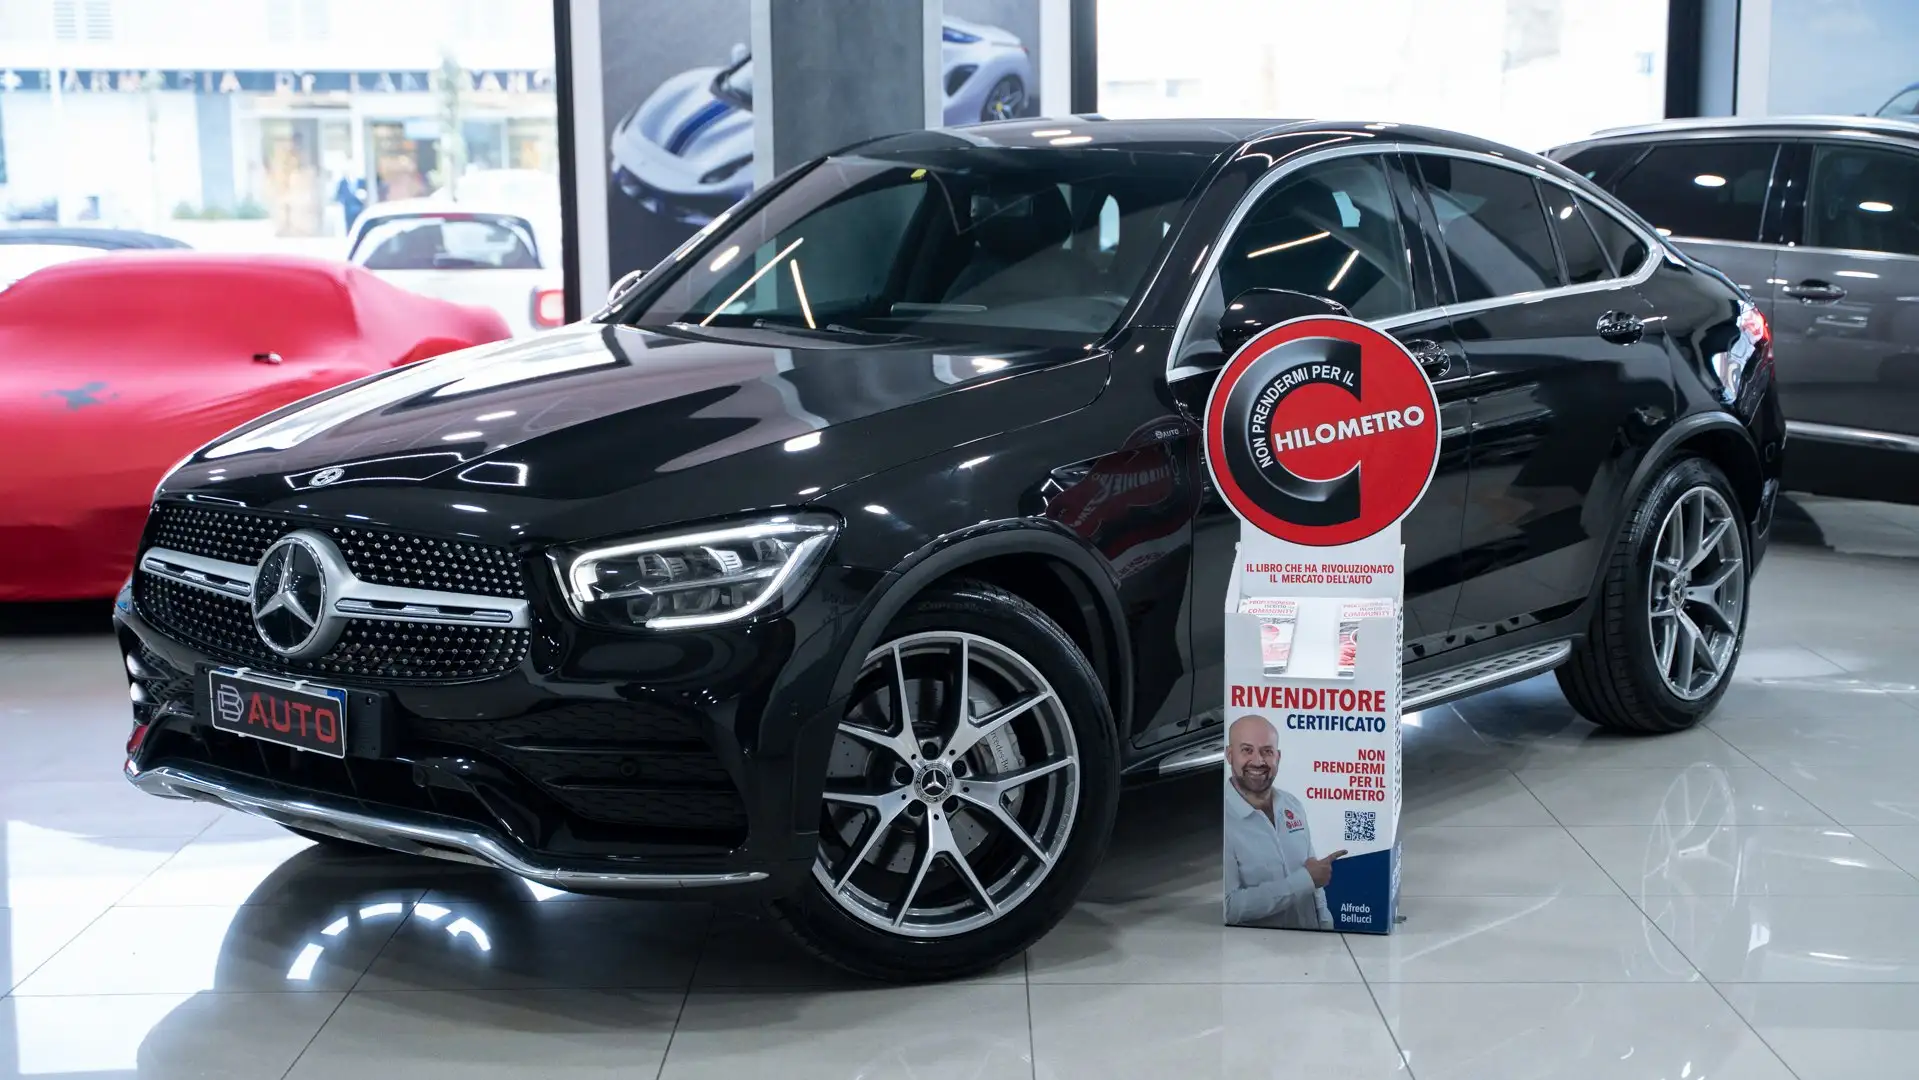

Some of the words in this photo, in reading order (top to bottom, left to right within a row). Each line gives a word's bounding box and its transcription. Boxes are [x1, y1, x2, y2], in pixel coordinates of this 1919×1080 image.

[1312, 365, 1340, 381] PER
[1342, 371, 1355, 387] IL
[1252, 366, 1309, 433] PRENDERMI
[1252, 439, 1274, 468] NON
[1246, 563, 1254, 573] IL
[1256, 563, 1283, 573] LIBRO
[1284, 563, 1303, 573] CHE
[1304, 564, 1318, 573] HA
[1321, 564, 1395, 574] RIVOLUZIONATO
[1269, 574, 1278, 583] IL
[1281, 574, 1324, 584] MERCATO
[1326, 575, 1373, 584] DELL'AUTO
[1231, 685, 1386, 713] RIVENDITORE
[248, 691, 337, 744] AUTO
[1286, 713, 1386, 733] CERTIFICATO
[1358, 749, 1385, 761] NON
[1313, 761, 1385, 775] PRENDERMI
[1349, 776, 1372, 788] PER
[1375, 777, 1386, 788] IL
[1306, 787, 1385, 802] CHILOMETRO
[1340, 903, 1371, 913] Alfredo
[1340, 914, 1372, 924] Bellucci
